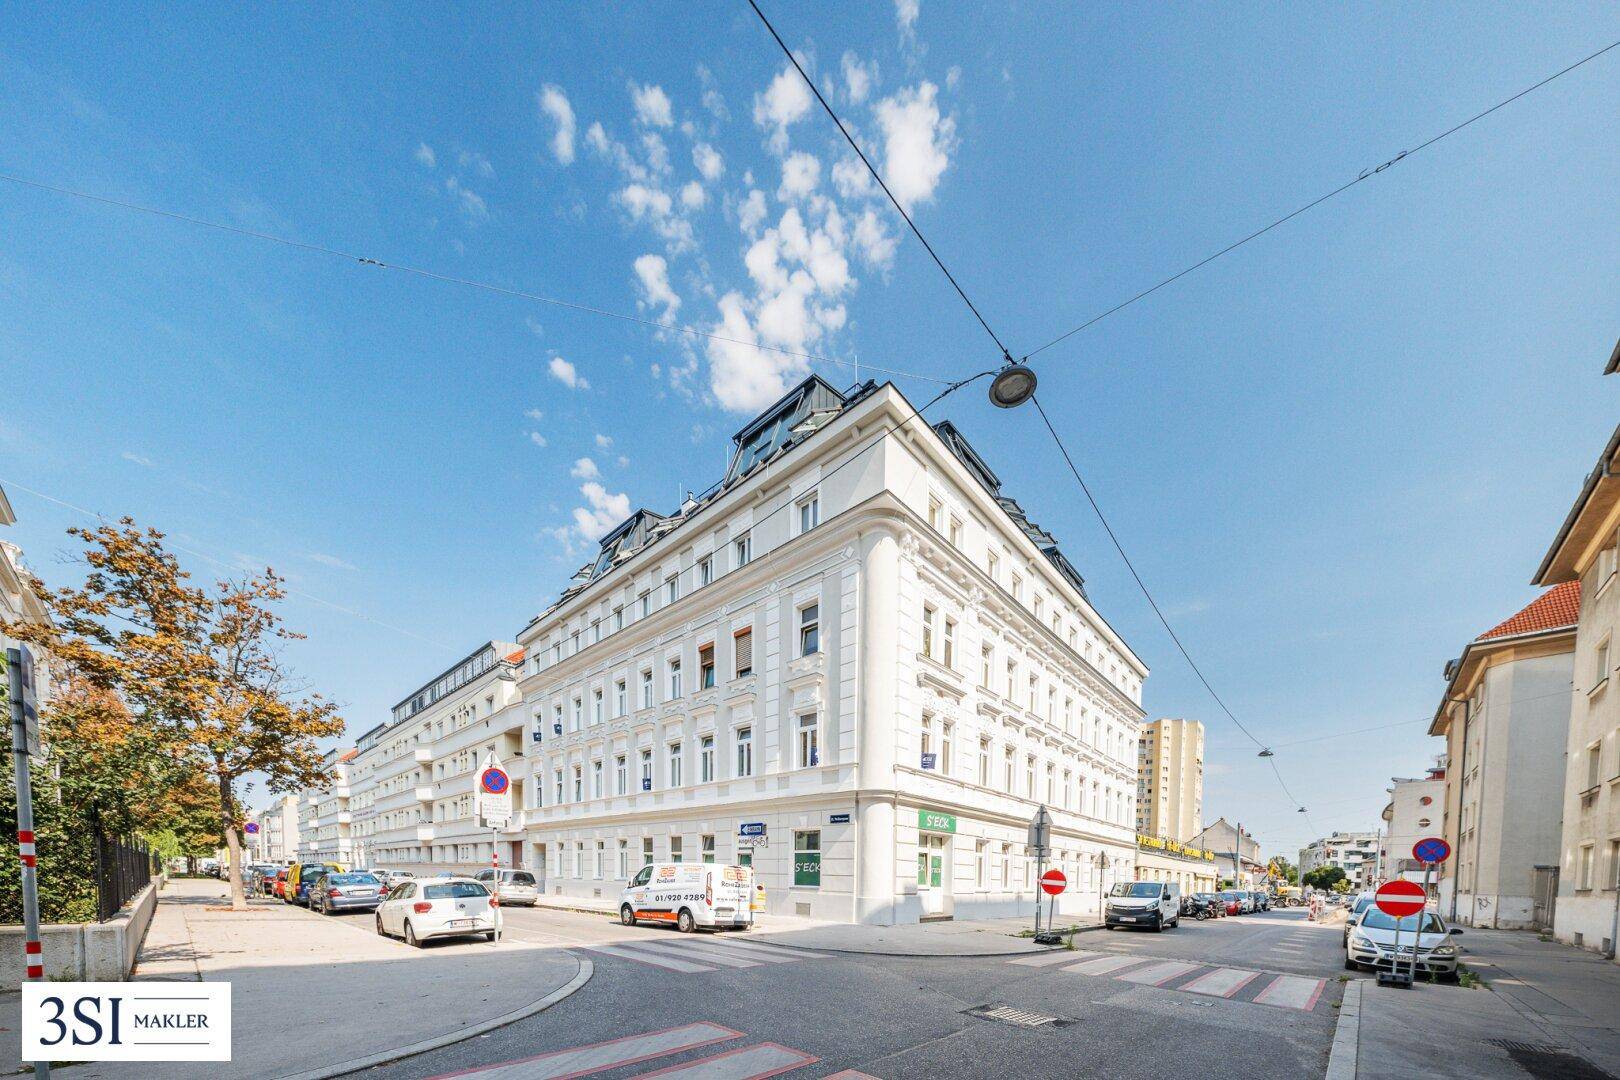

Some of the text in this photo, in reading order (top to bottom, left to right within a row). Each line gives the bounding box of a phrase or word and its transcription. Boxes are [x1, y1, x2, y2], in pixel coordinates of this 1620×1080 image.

[927, 814, 949, 829] S'ECK
[655, 894, 682, 902] 01/920
[683, 893, 705, 901] 4289
